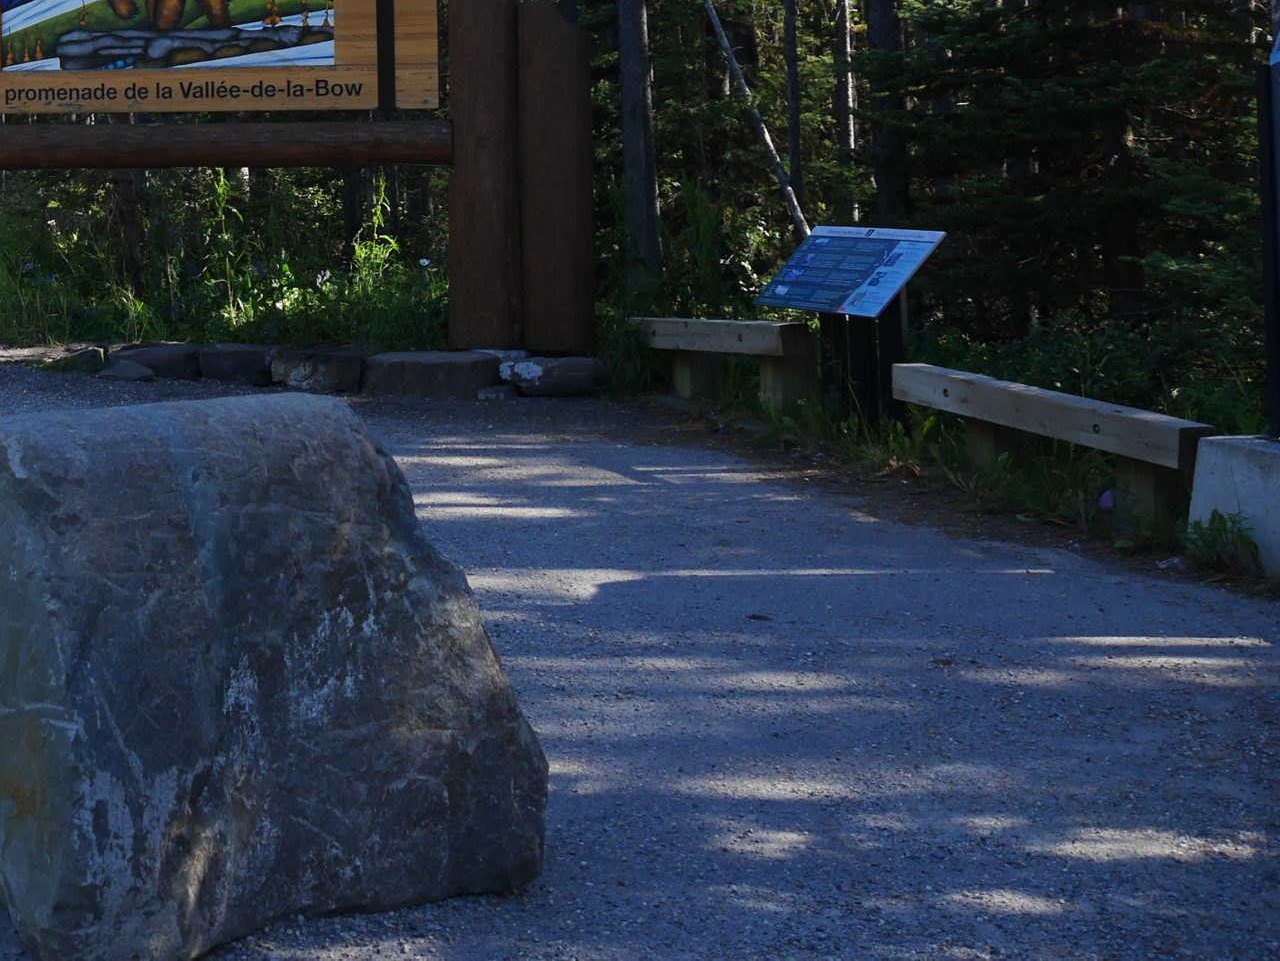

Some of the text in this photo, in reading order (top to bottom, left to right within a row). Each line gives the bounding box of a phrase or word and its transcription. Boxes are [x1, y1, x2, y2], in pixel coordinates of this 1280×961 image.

[4, 83, 117, 105] promenade
[124, 82, 149, 100] de
[155, 81, 173, 99] la
[179, 78, 364, 99] Vallée-de-la-Bow
